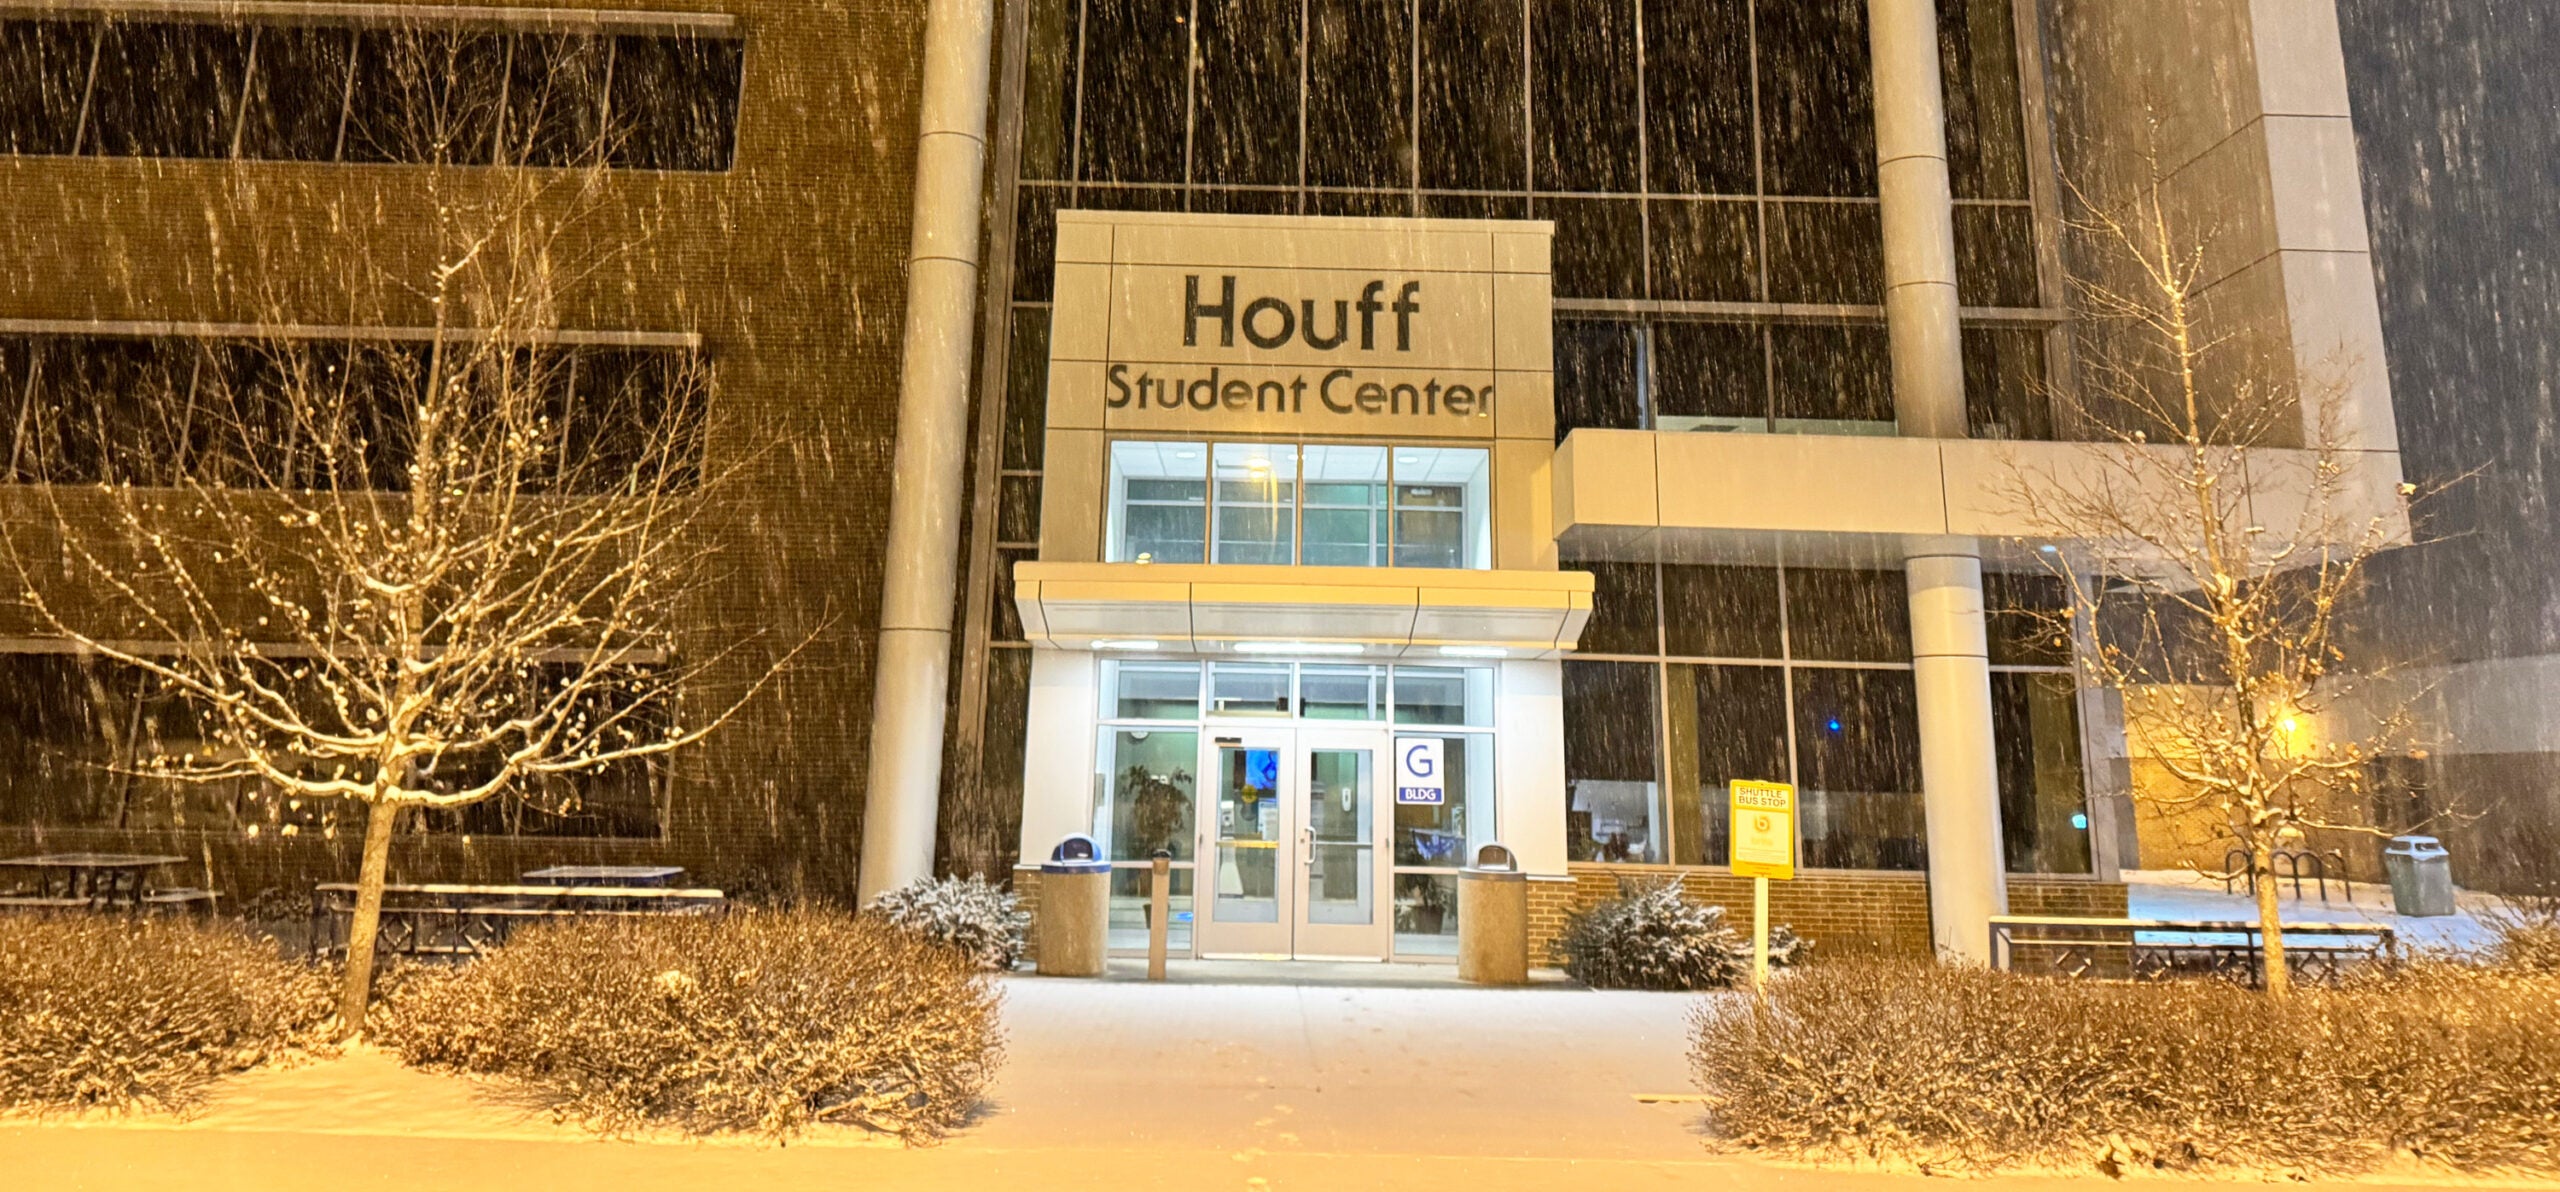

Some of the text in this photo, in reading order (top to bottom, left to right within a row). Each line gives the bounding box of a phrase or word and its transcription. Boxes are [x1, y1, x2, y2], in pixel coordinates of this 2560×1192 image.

[1183, 275, 1420, 351] Houff
[1107, 364, 1492, 416] Student Center
[1406, 744, 1433, 778] G
[1405, 788, 1436, 800] BLDG
[1739, 787, 1782, 798] SHUTTLE
[1739, 796, 1786, 807] BUS STOP
